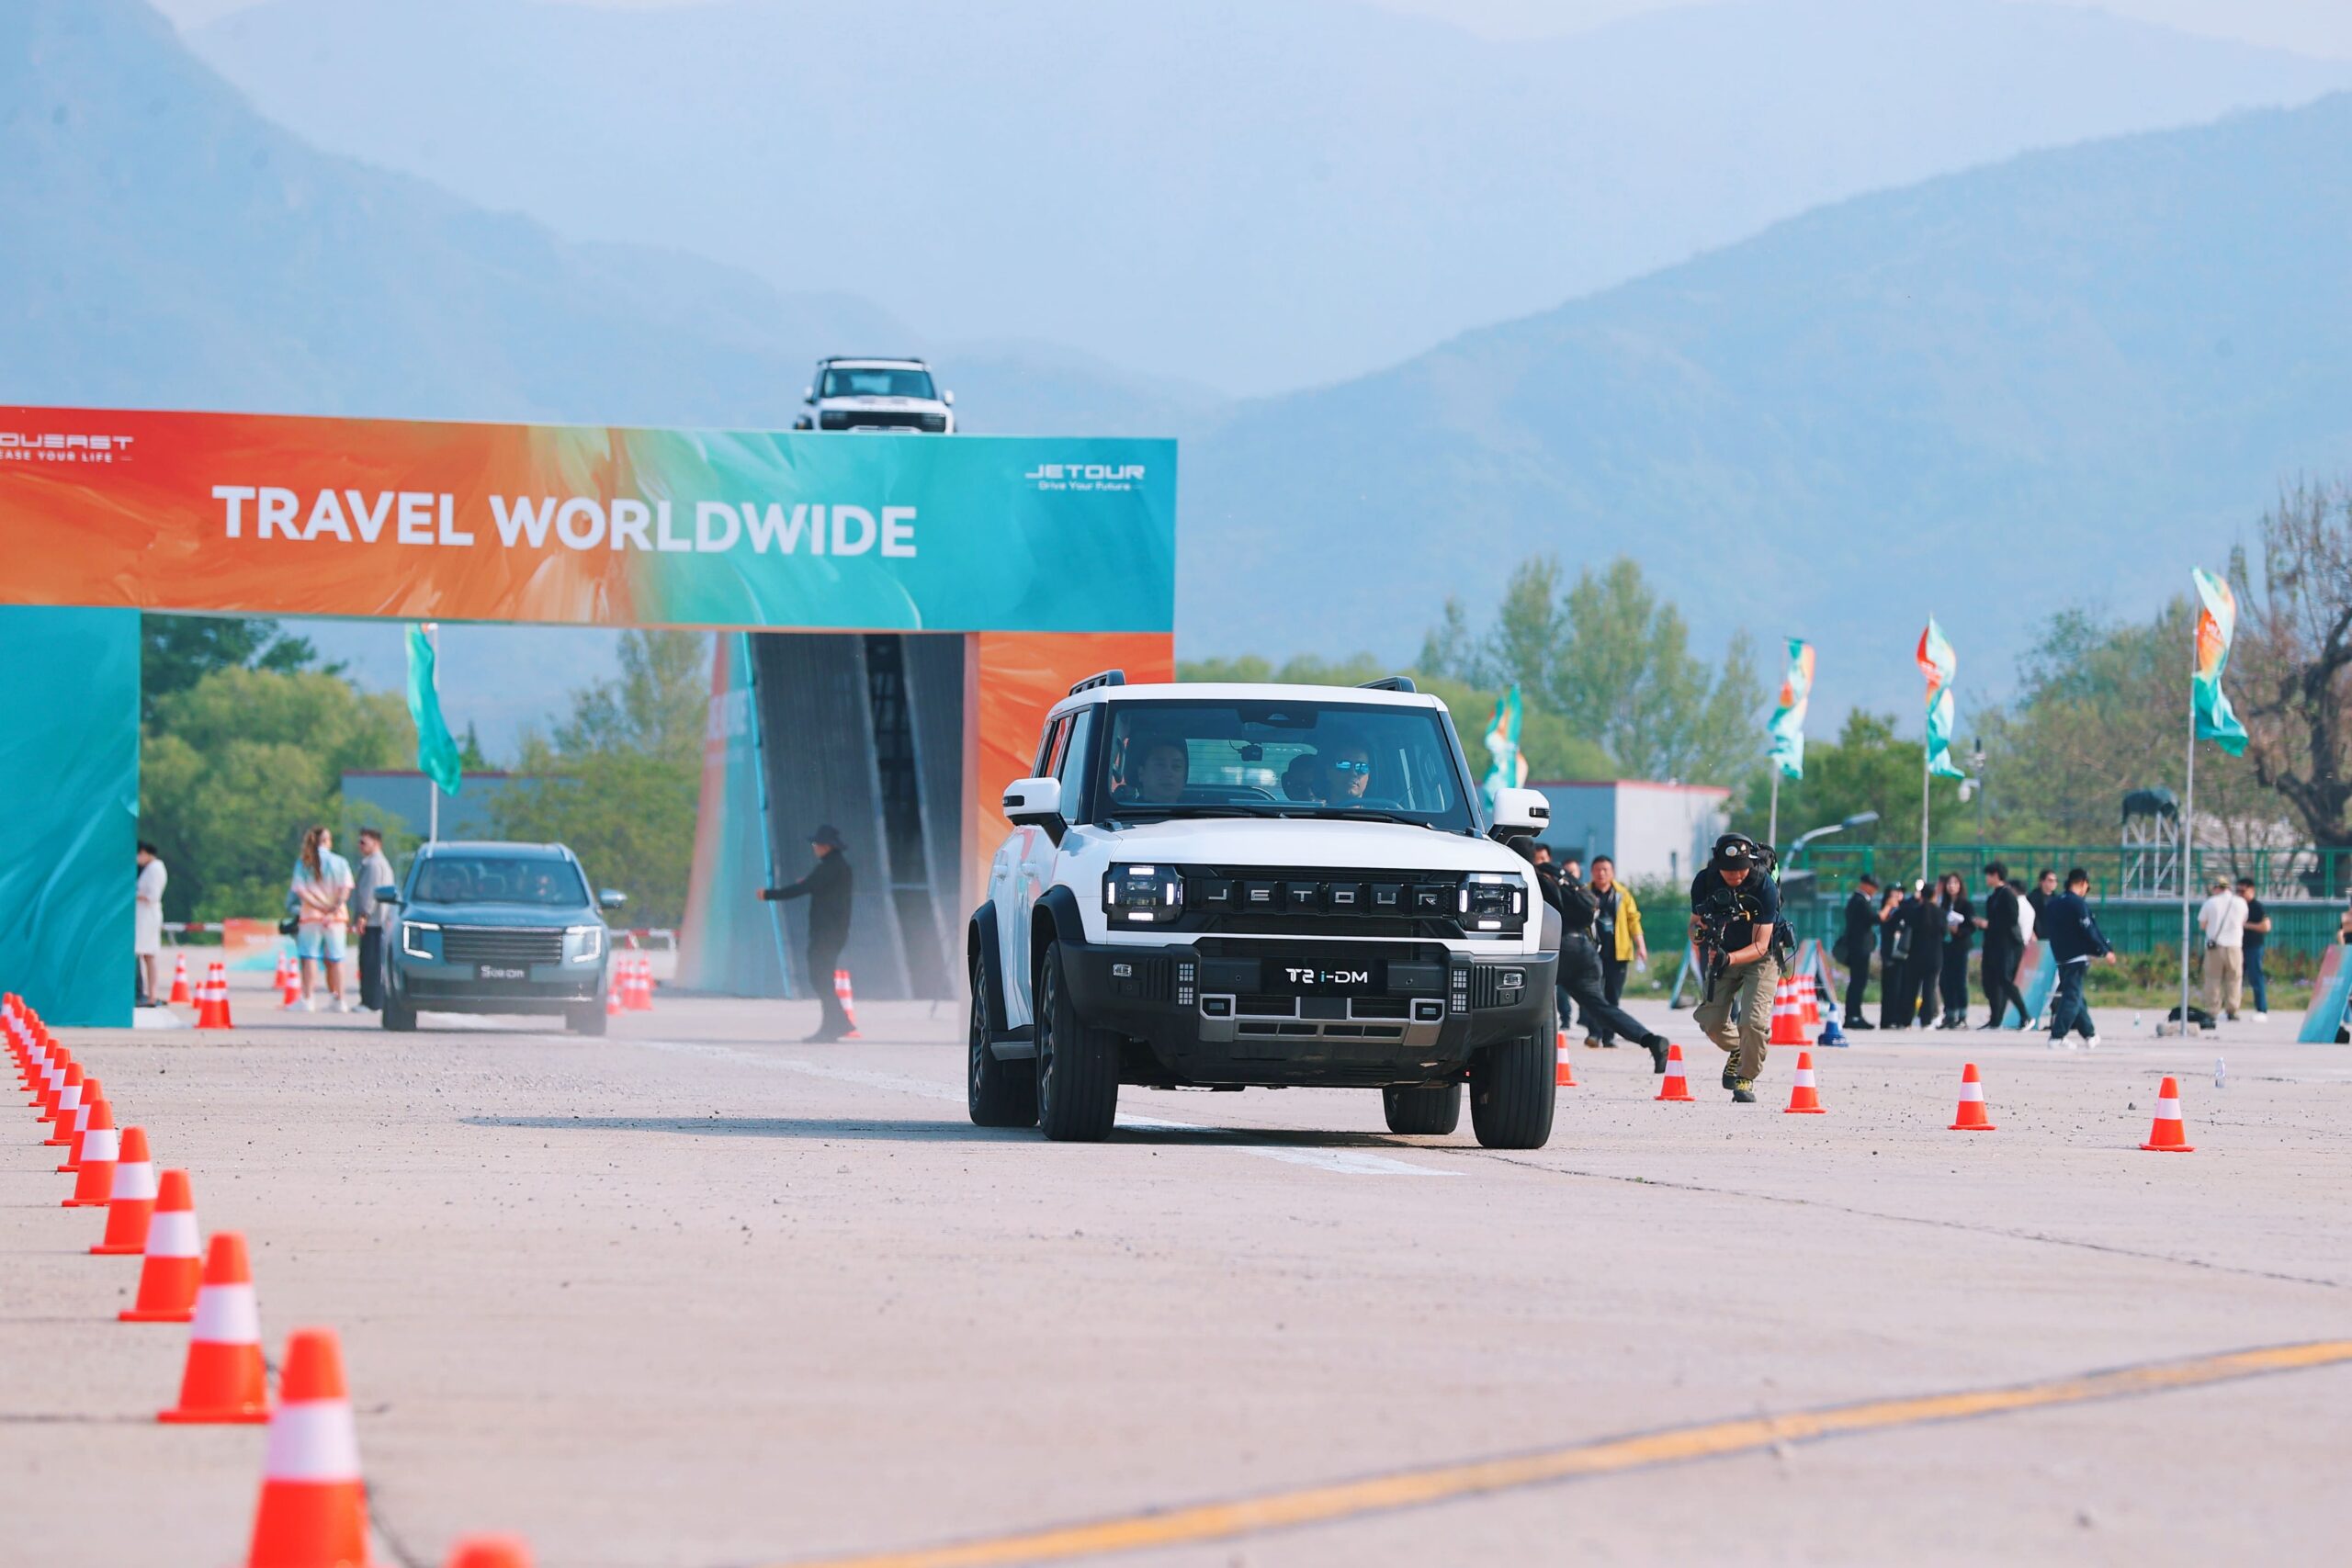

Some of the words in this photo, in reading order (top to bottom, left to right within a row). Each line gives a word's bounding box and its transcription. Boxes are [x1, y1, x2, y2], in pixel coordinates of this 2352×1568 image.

[38, 449, 76, 462] YOUR
[81, 451, 112, 463] LIFE
[1024, 463, 1146, 480] JETOUR
[1069, 480, 1093, 491] Your
[211, 484, 475, 547] TRAVEL
[488, 494, 918, 558] WORLDWIDE
[1207, 888, 1438, 906] JETOUR
[1285, 967, 1315, 984] T2
[1320, 970, 1368, 984] i-DM
